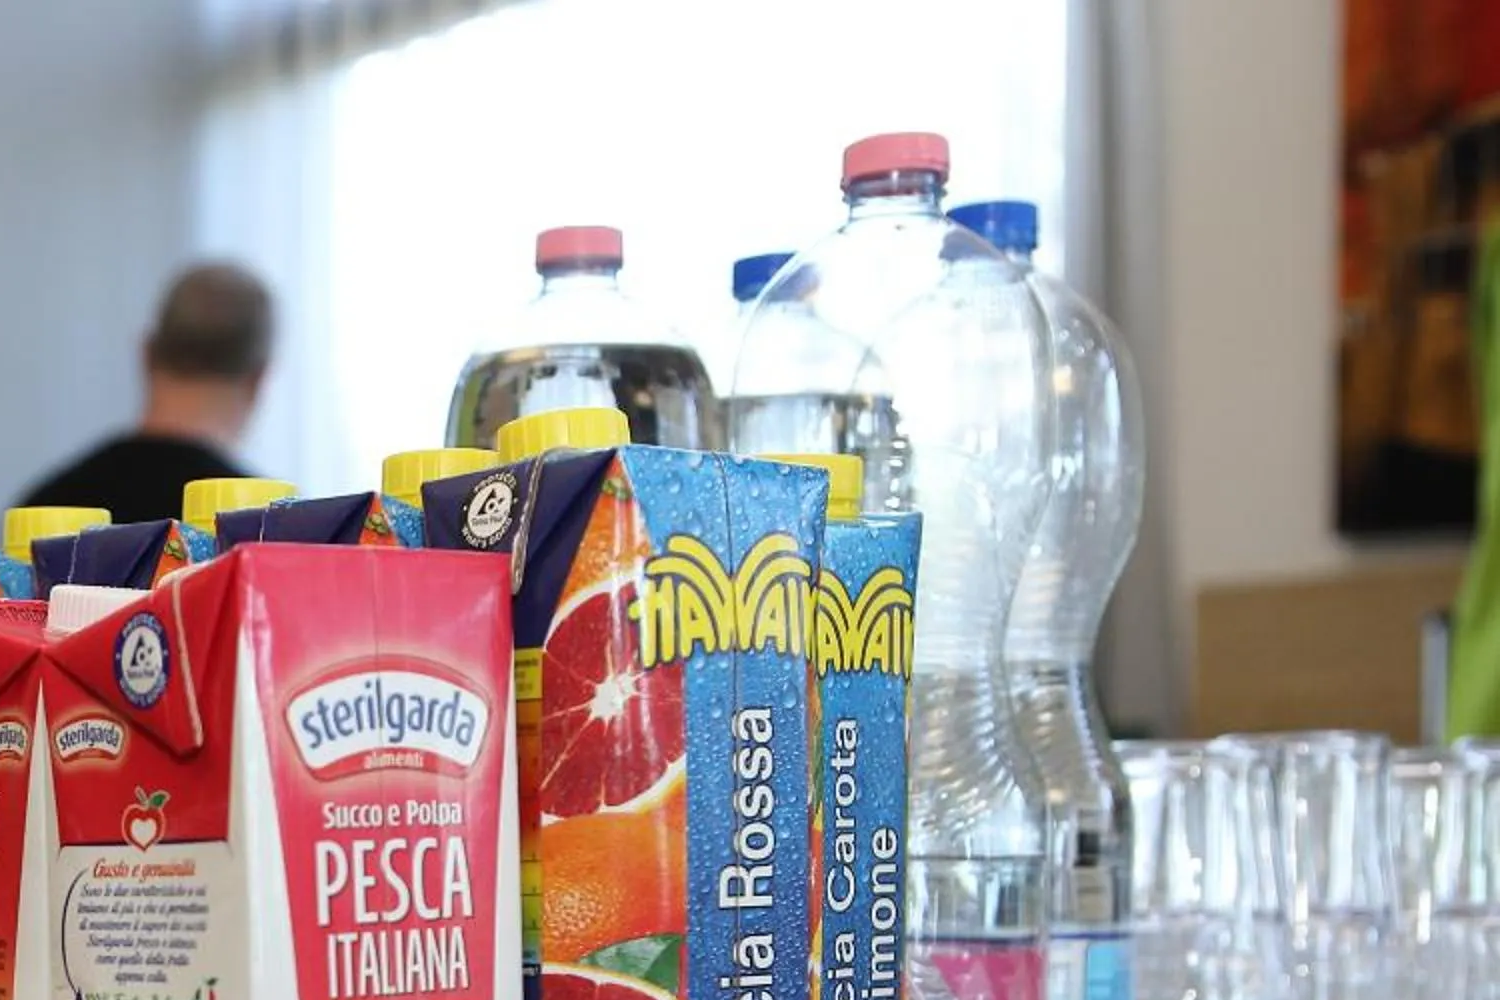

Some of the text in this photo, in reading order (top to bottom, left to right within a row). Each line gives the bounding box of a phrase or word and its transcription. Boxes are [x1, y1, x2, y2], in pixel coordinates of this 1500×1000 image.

[302, 678, 476, 749] sterilgarda
[323, 800, 463, 829] Succo e Polpa
[719, 707, 776, 909] Rossa
[827, 718, 858, 913] Carota
[314, 836, 473, 927] PESCA
[327, 926, 470, 1000] ITALIANA
